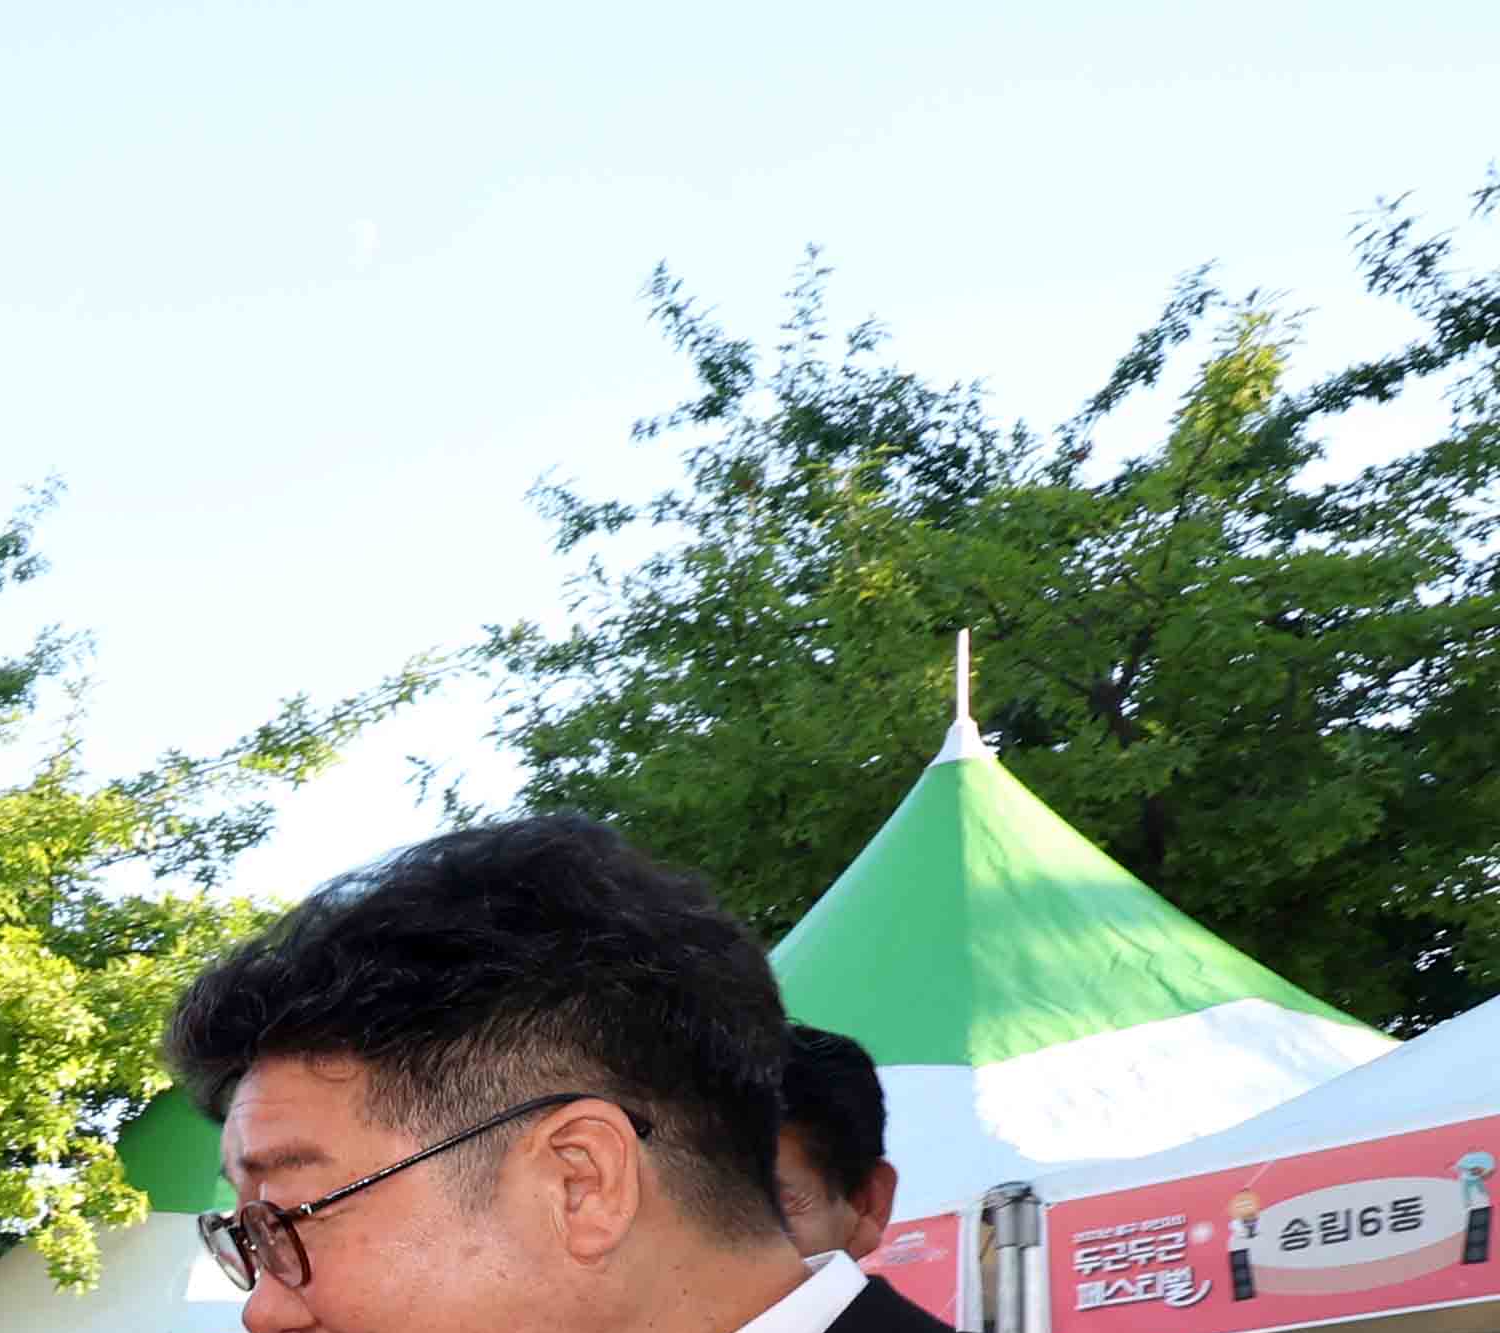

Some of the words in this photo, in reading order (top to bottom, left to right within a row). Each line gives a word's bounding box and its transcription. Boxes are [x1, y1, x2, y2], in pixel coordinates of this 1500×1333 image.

[1279, 1196, 1425, 1251] 송림6동
[1073, 1231, 1187, 1275] 두근두근
[1075, 1266, 1212, 1311] 페스티벌
